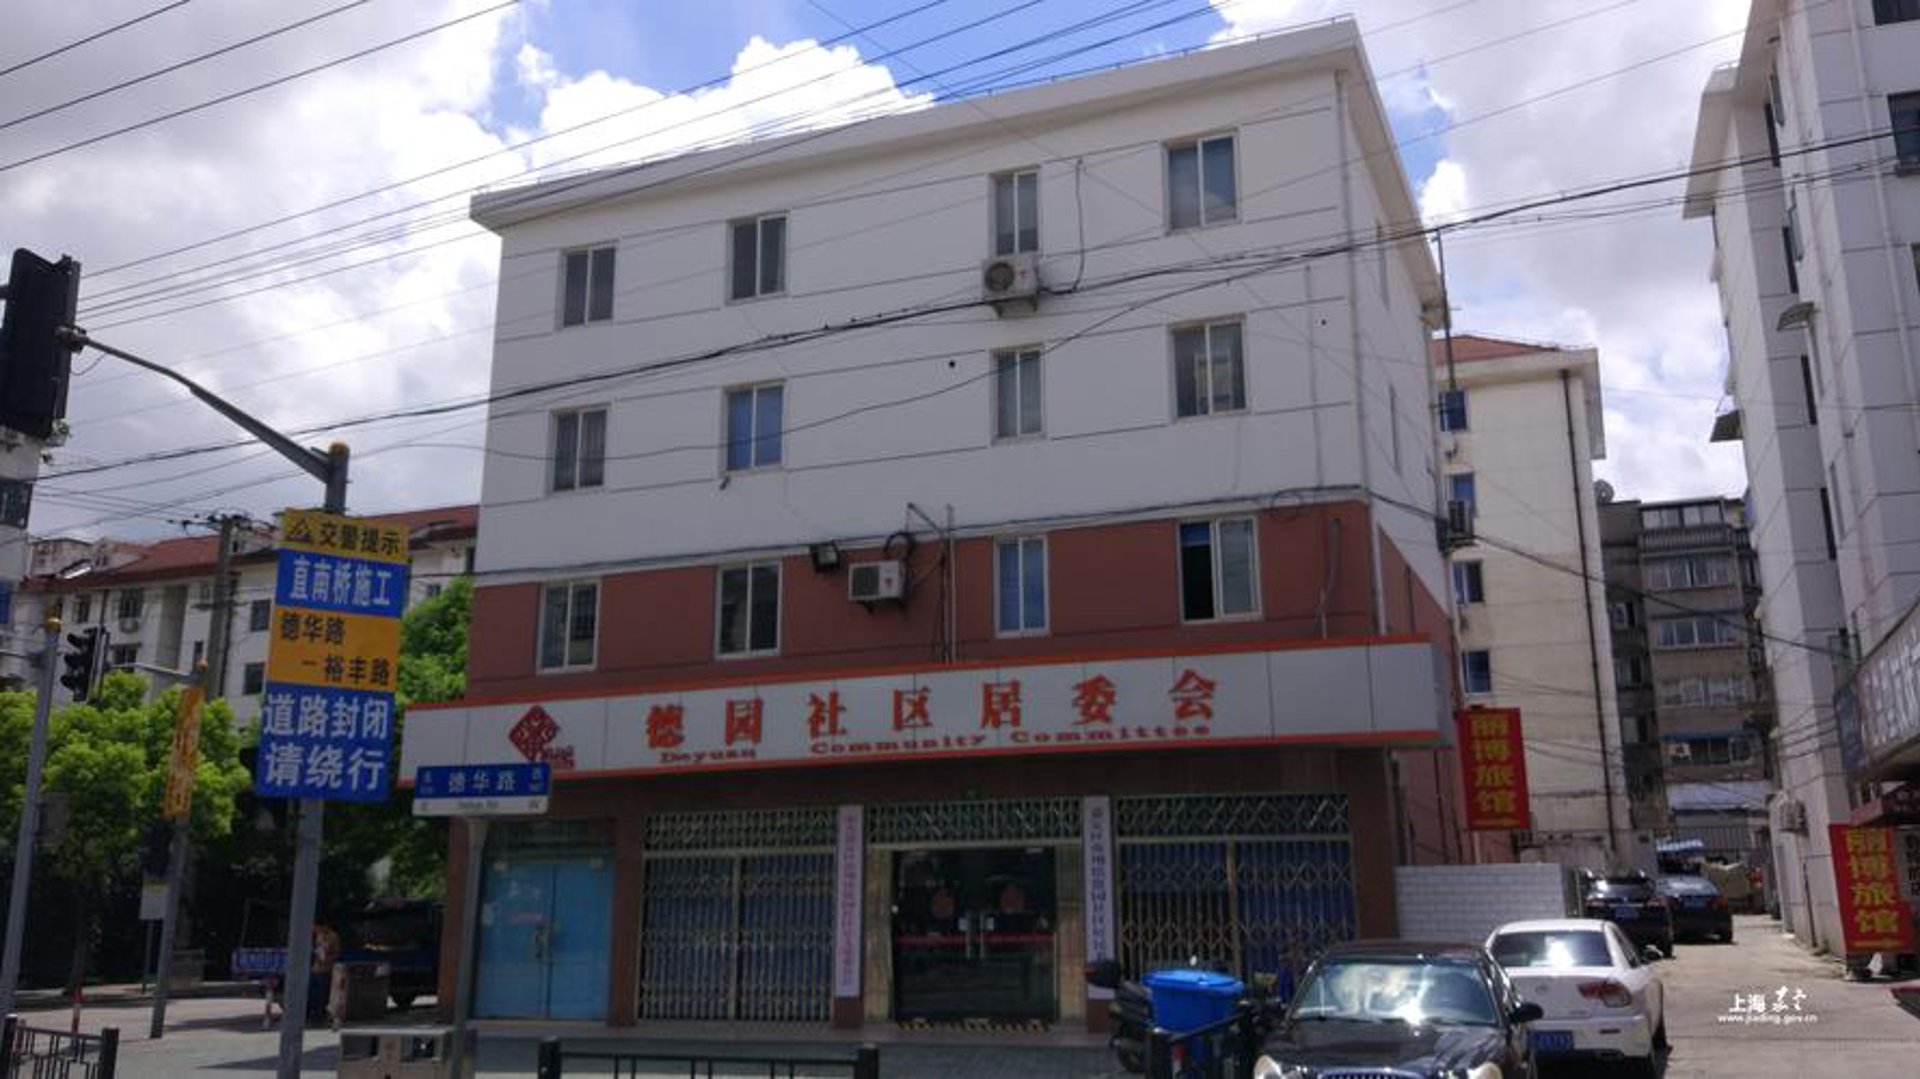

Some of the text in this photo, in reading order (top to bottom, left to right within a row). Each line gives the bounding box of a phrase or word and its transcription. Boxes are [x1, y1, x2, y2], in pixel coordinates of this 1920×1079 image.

[281, 613, 346, 646] 德华路
[263, 693, 389, 740] 道路封闭
[646, 668, 1216, 750] 德园社区居委会
[811, 733, 987, 755] Community
[1010, 724, 1211, 744] Committee
[1469, 712, 1517, 813] 丽博旅馆
[264, 742, 385, 791] 请绕行
[448, 769, 516, 795] 德华路
[1845, 828, 1901, 934] 丽博旅馆
